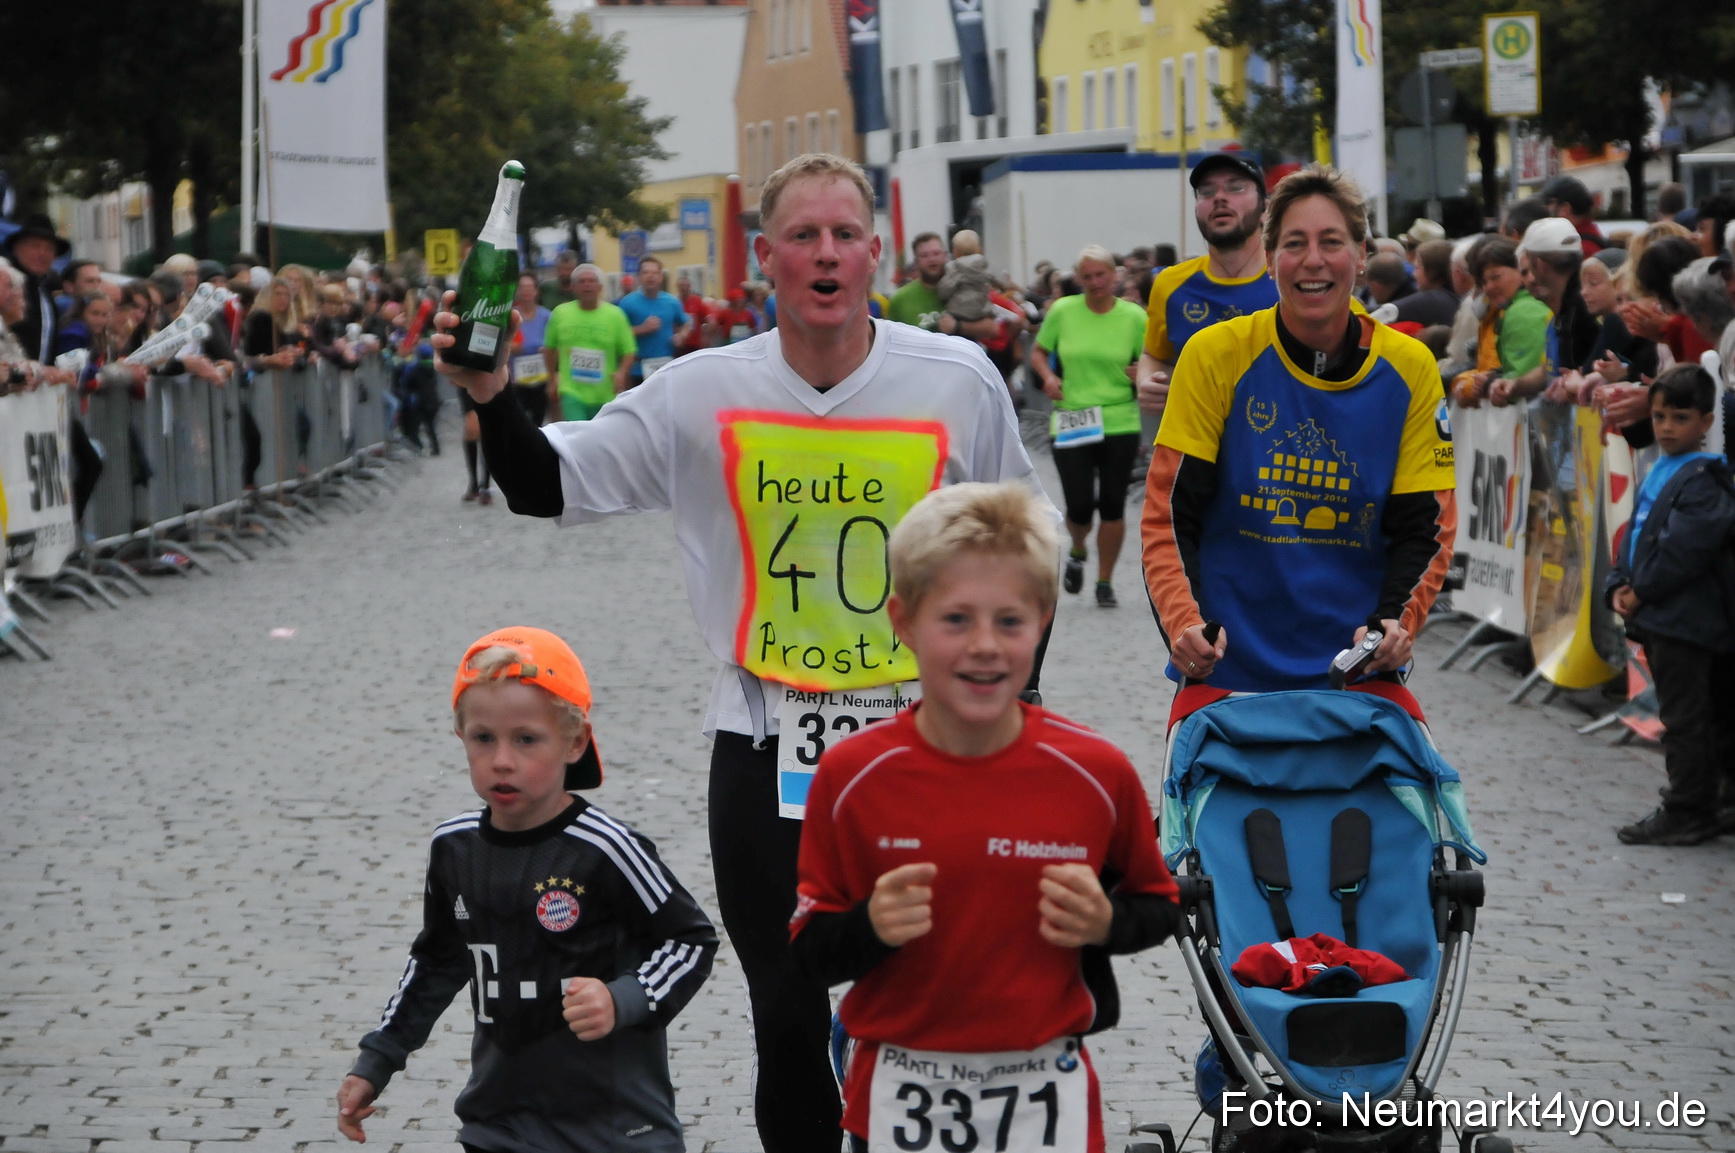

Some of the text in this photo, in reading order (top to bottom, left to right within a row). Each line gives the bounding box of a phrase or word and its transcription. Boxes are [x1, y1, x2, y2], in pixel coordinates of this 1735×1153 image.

[571, 353, 600, 369] 2323
[1256, 402, 1266, 410] 15
[757, 459, 885, 504] heute
[1324, 493, 1347, 504] 2014
[1239, 527, 1362, 548] www.stadtlauf-neumarkt.de
[767, 513, 892, 615] 40
[760, 621, 902, 674] Prost!
[786, 690, 838, 706] PARTL
[988, 837, 1088, 860] FC Holzheim
[951, 1058, 1047, 1084] Neumarkt
[892, 1081, 1059, 1153] 3371
